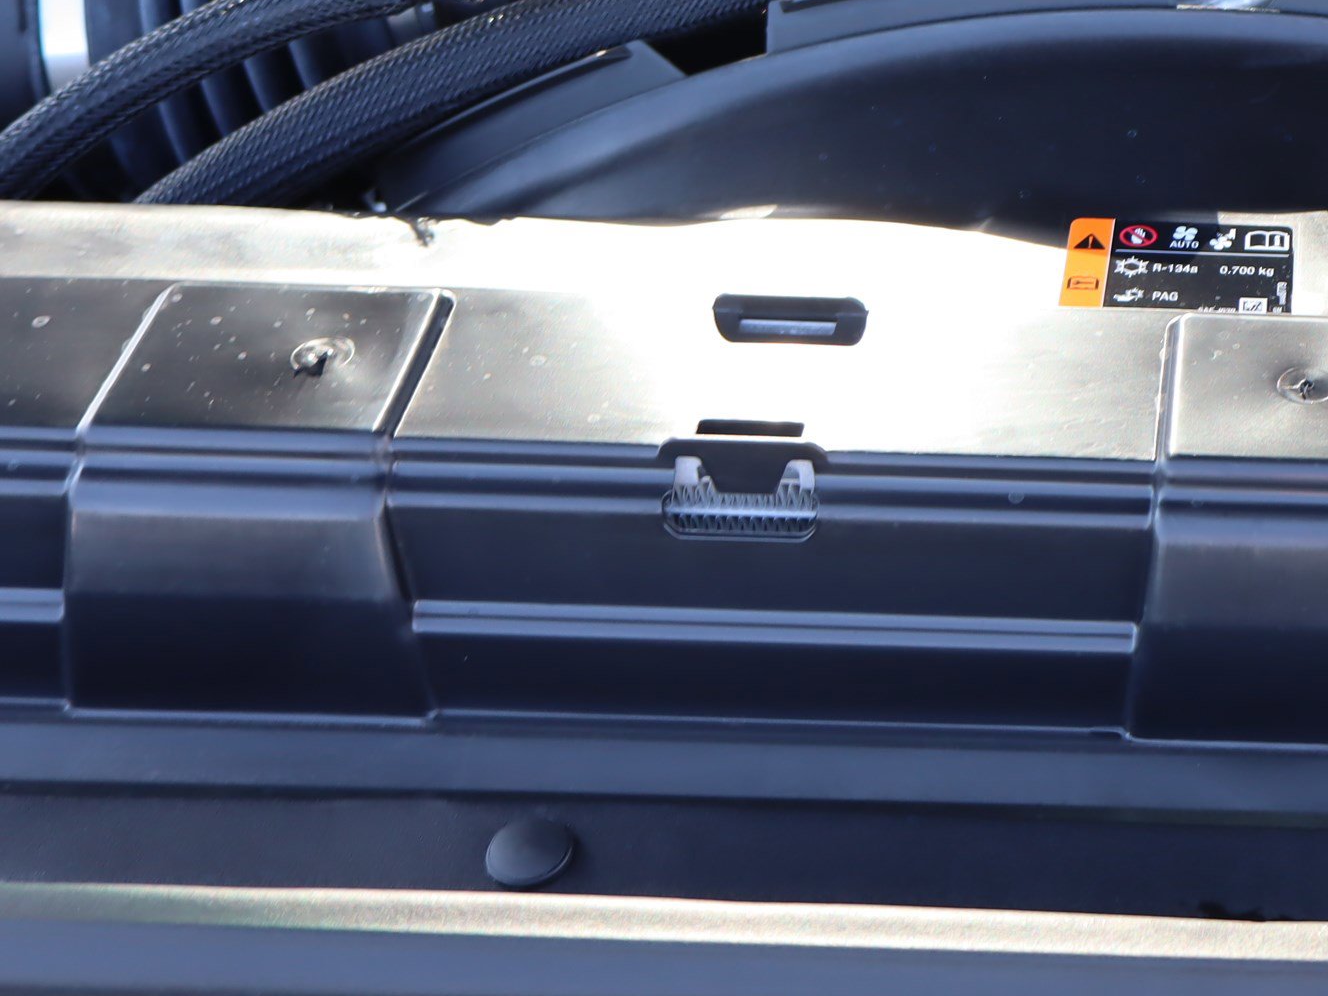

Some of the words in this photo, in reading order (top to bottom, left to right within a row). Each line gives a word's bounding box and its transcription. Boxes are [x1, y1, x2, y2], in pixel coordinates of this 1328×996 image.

[1169, 239, 1200, 249] AUTO
[1152, 262, 1198, 274] R-134a
[1219, 265, 1256, 276] 0.700
[1258, 266, 1275, 278] kg
[1151, 290, 1179, 302] PAG
